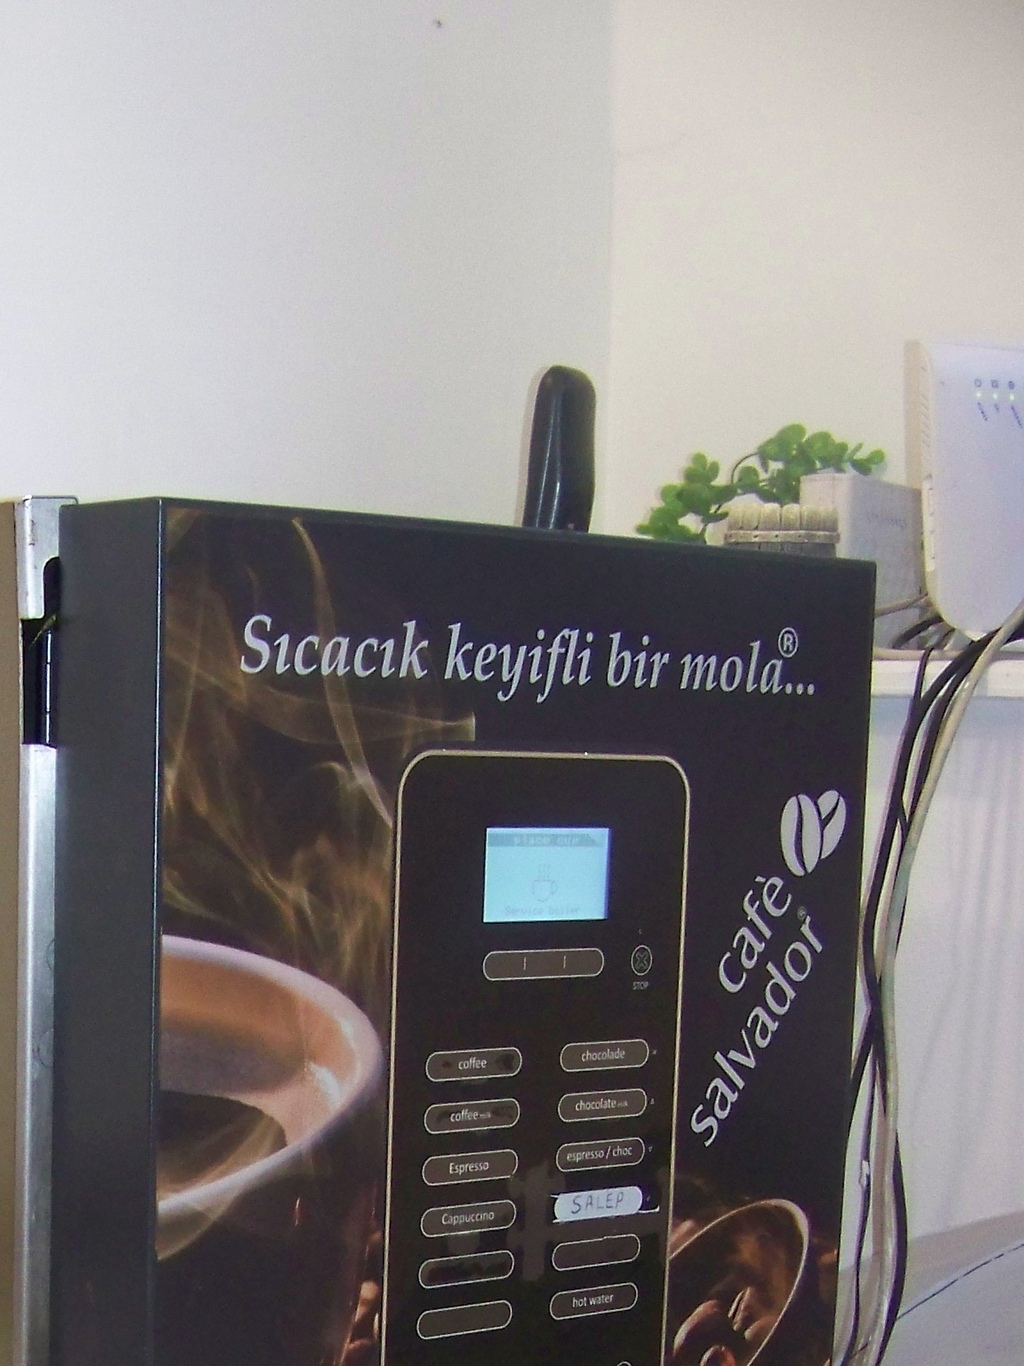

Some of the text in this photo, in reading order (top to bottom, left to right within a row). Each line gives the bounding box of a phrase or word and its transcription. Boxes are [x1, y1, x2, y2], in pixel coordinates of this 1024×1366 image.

[444, 622, 592, 704] keyifli
[607, 632, 670, 688] bir
[632, 981, 649, 991] STOP
[690, 915, 823, 1148] salvador
[581, 1048, 625, 1063] chocolade
[458, 1056, 488, 1071] coffee
[575, 1097, 616, 1112] chocolate
[450, 1108, 479, 1122] coffee
[567, 1146, 605, 1163] espresso
[612, 1144, 633, 1159] choc
[449, 1160, 489, 1176] Espresso
[571, 1190, 625, 1214] SALEP
[442, 1209, 495, 1227] Cappuccino
[572, 1293, 614, 1308] hot water
